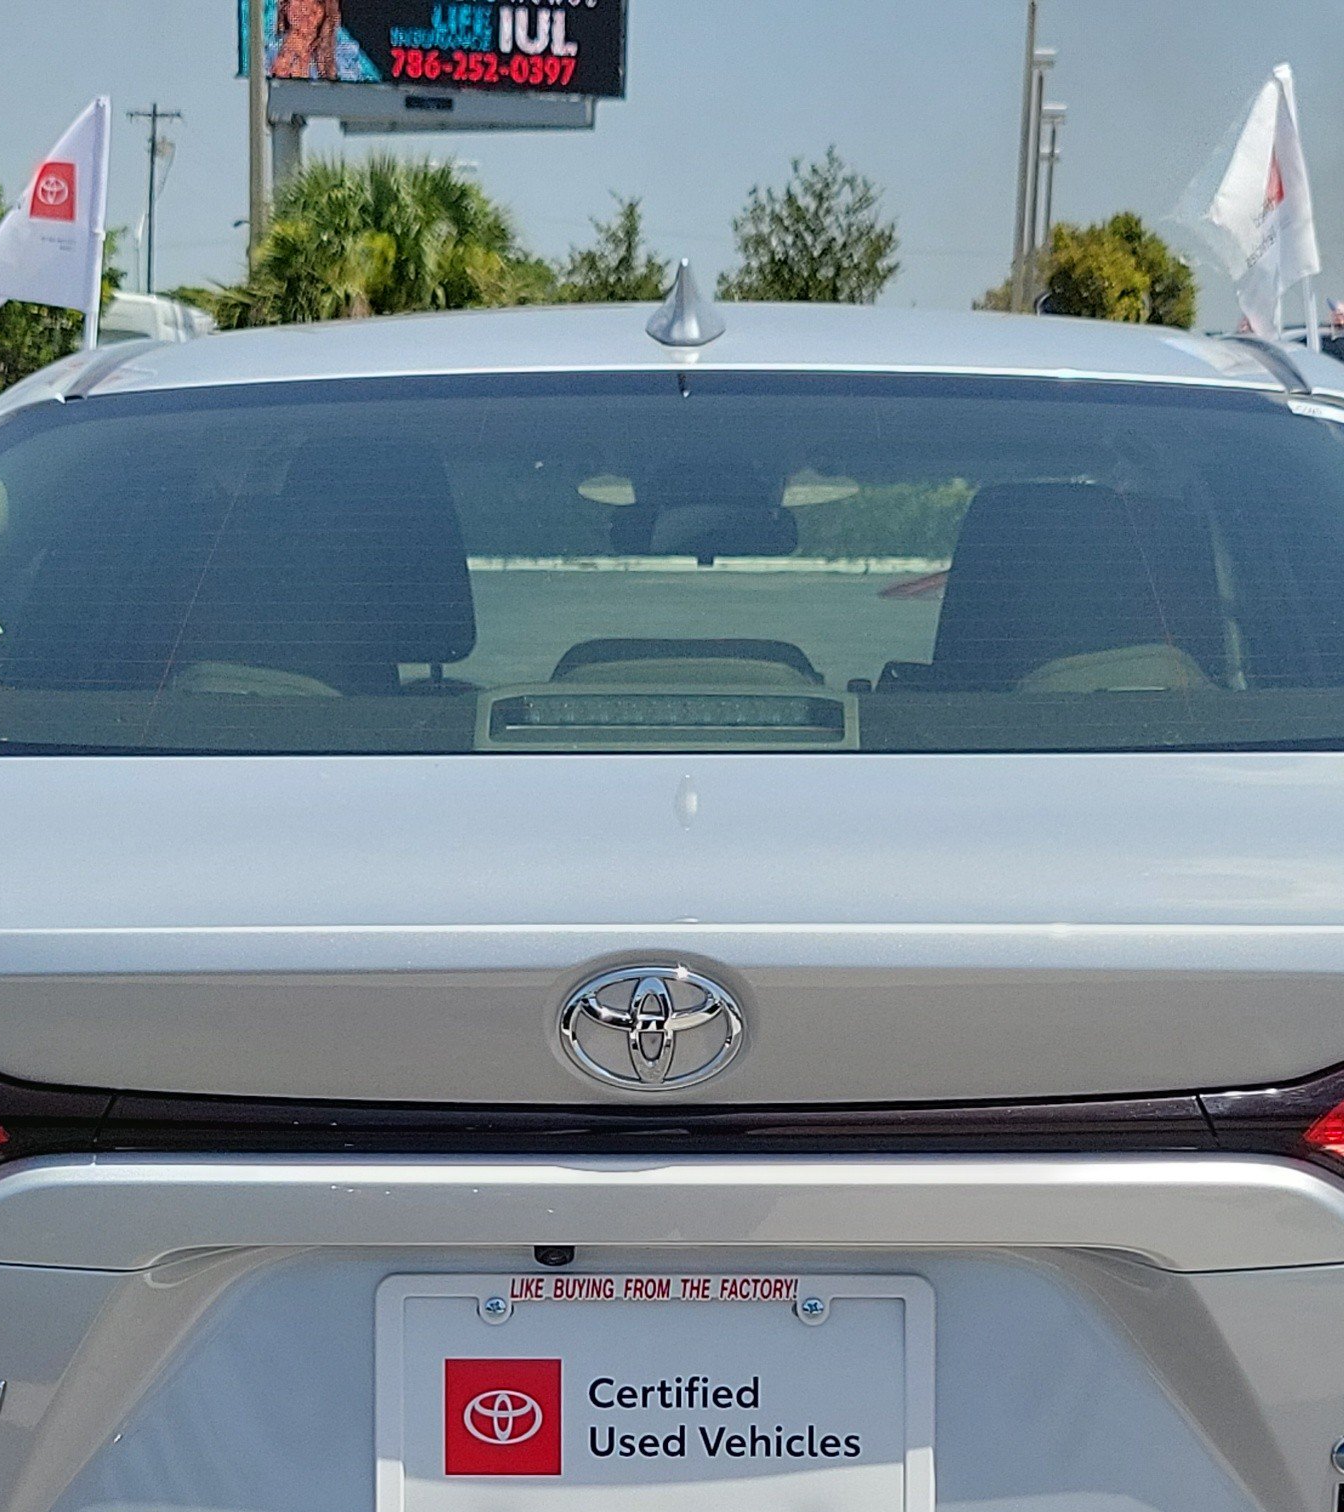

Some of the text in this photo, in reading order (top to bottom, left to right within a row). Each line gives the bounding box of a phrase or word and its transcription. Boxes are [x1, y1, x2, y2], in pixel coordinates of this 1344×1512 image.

[431, 4, 492, 36] LIFE
[499, 6, 578, 56] IUL
[391, 48, 576, 86] 786-252-0397
[510, 1279, 799, 1299] LIKE BUYING FROM THE FACTORY!
[588, 1377, 760, 1408] Certified
[589, 1427, 861, 1457] Used Vehicles
